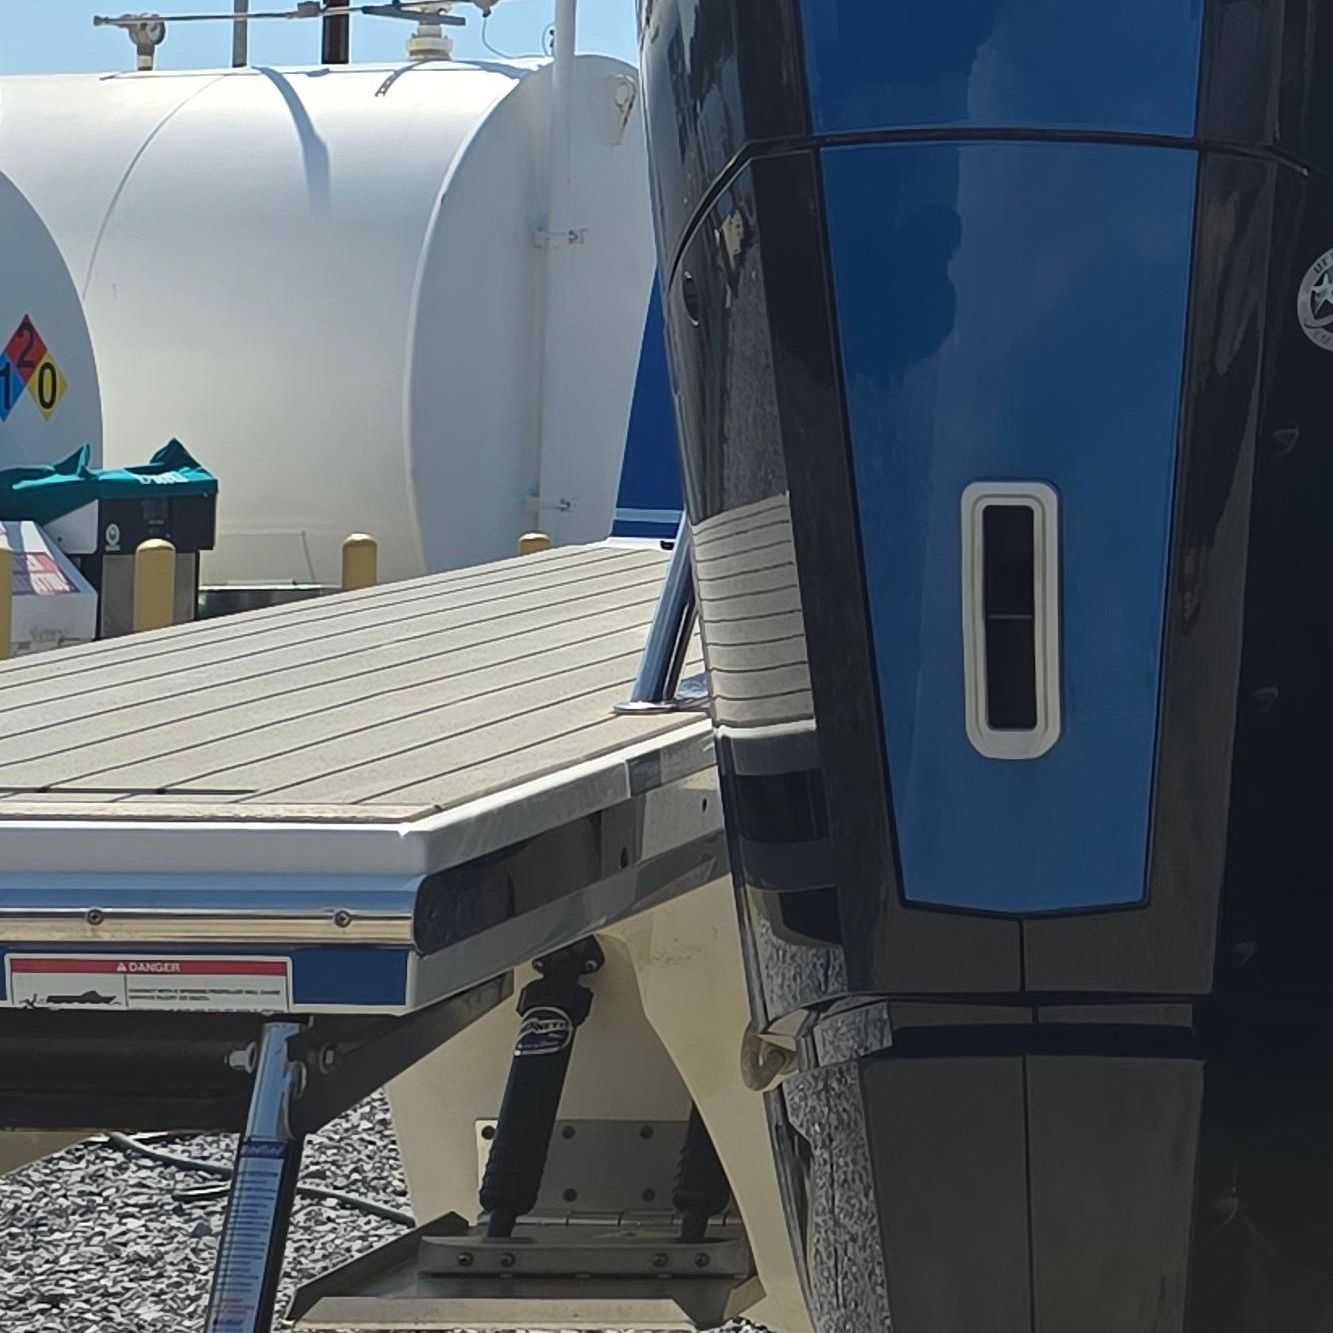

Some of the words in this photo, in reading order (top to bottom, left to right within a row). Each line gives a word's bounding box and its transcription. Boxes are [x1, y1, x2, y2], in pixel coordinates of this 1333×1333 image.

[18, 326, 35, 366] 2
[38, 362, 57, 409] 0
[128, 962, 181, 973] DANGER
